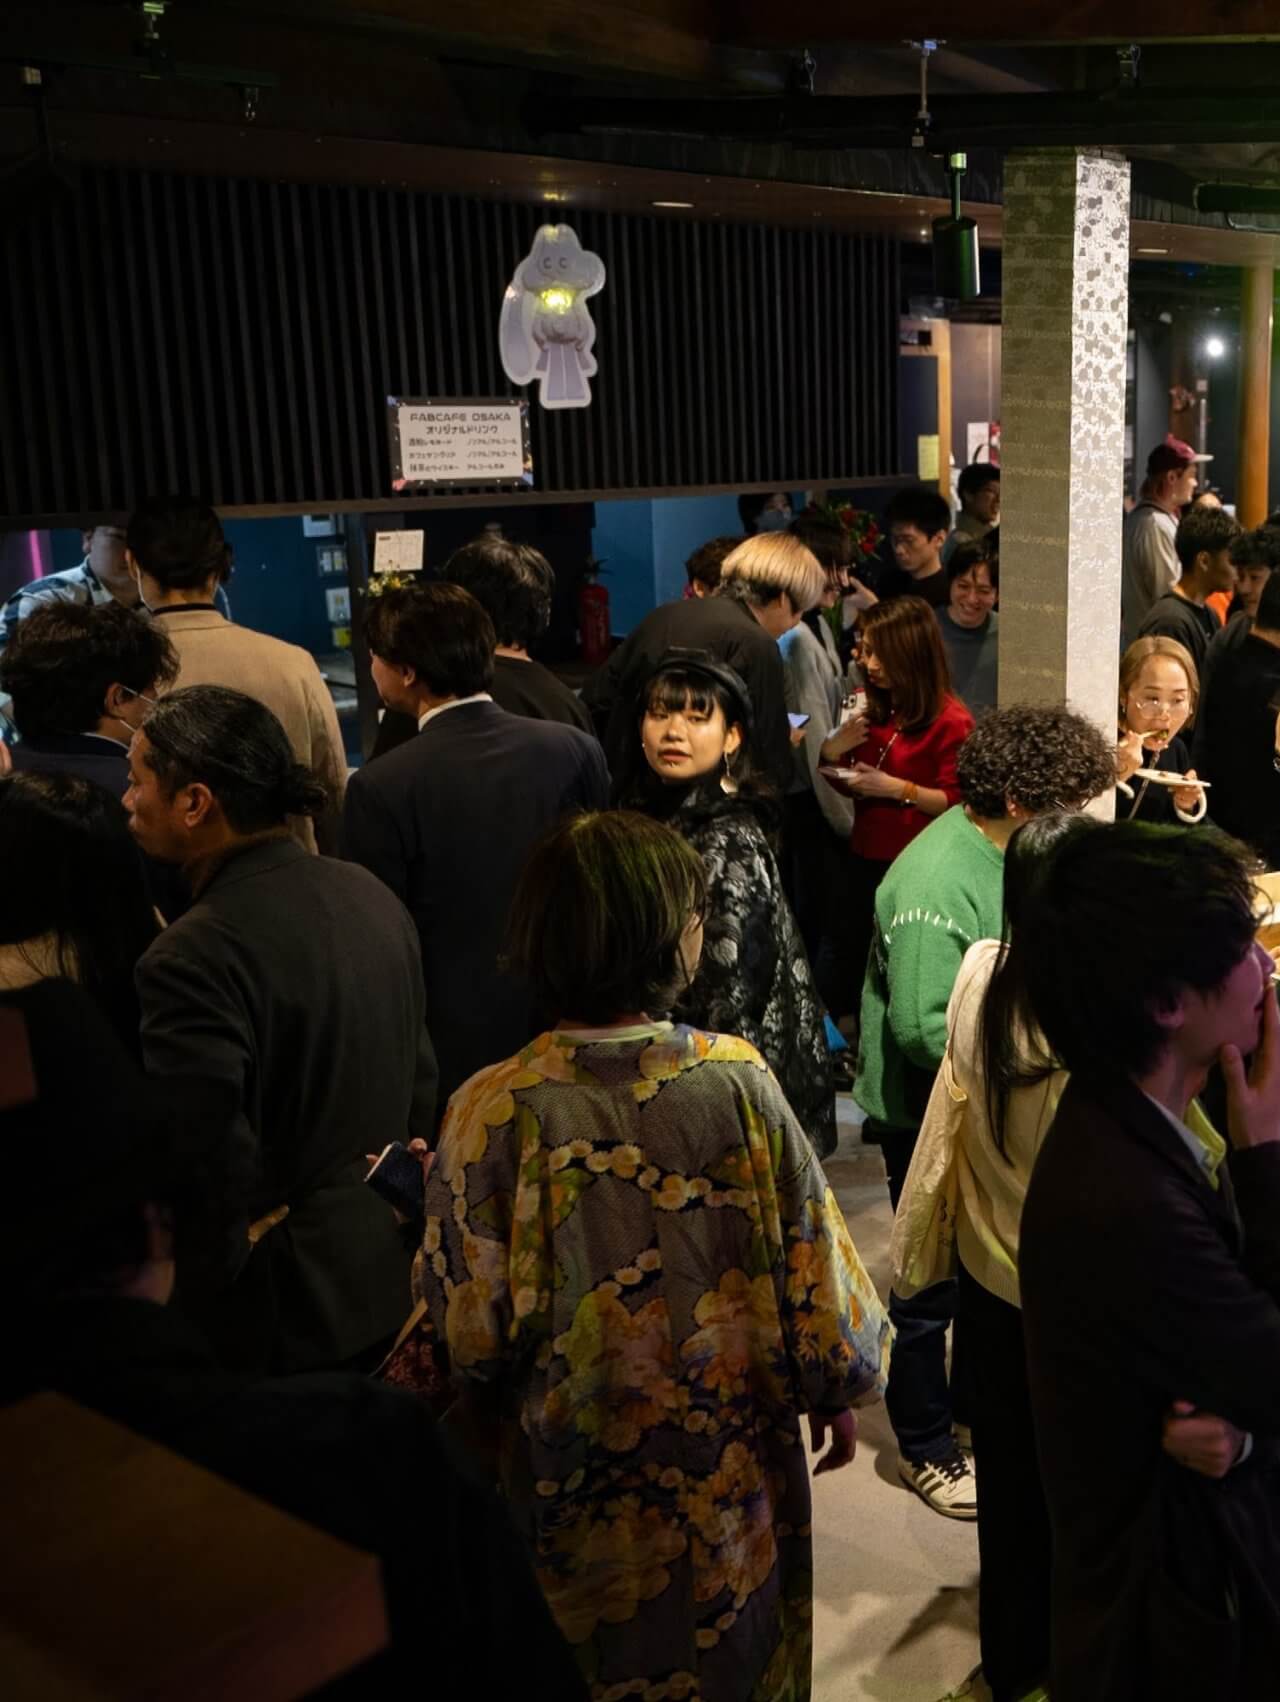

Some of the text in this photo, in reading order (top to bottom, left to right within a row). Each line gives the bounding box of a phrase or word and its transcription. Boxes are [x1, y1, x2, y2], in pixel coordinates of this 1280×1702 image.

[410, 412, 511, 422] FABCAFE OSAKA
[426, 424, 498, 435] オリジナルドリンク
